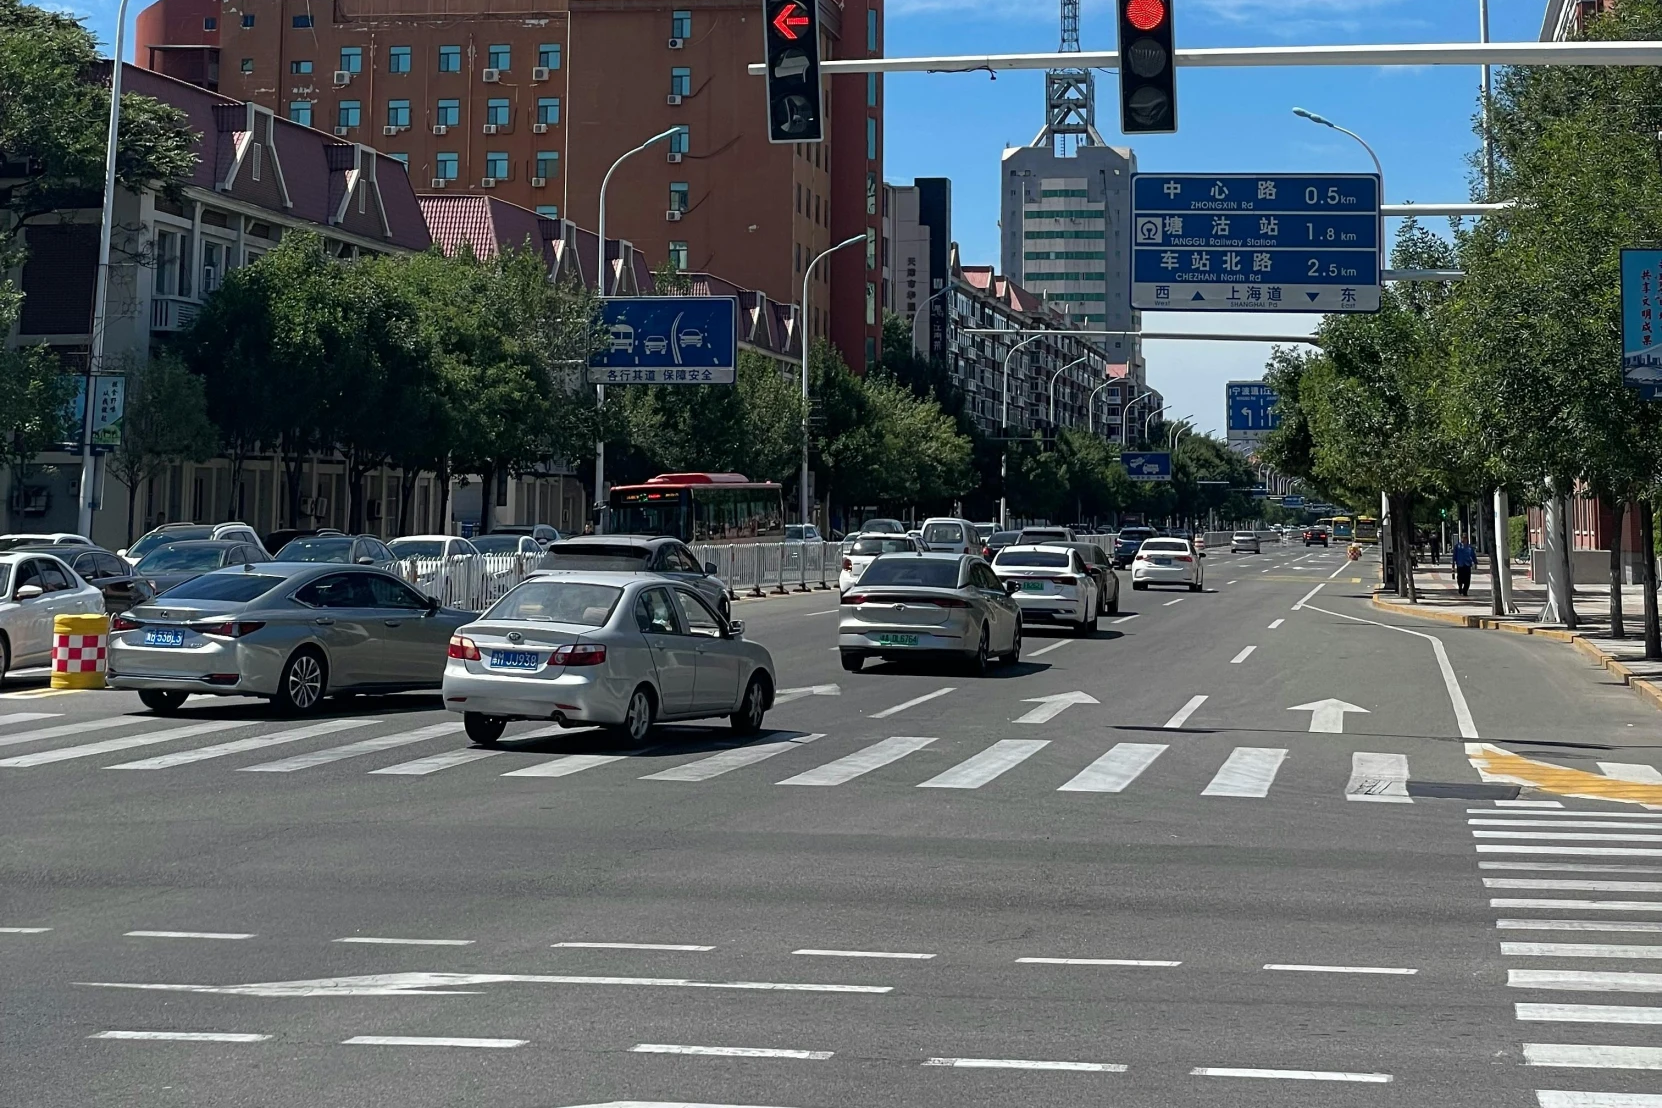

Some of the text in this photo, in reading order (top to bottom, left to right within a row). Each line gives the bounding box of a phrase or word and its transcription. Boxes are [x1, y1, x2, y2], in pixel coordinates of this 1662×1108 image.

[1163, 180, 1277, 200] 中心路
[1190, 201, 1254, 210] ZHONGXIN Rd
[1164, 216, 1279, 236] 塘沽站
[1170, 237, 1277, 247] TANGGU Railway Station
[1160, 251, 1273, 272] 车站北路
[1175, 272, 1261, 282] CHEZHAN North Rd
[1155, 285, 1170, 299] 西
[1226, 285, 1282, 302] 上海道
[1340, 287, 1356, 302] 东
[1641, 270, 1652, 345] 共享文明成果
[607, 369, 713, 382] 各行其道 保障安全
